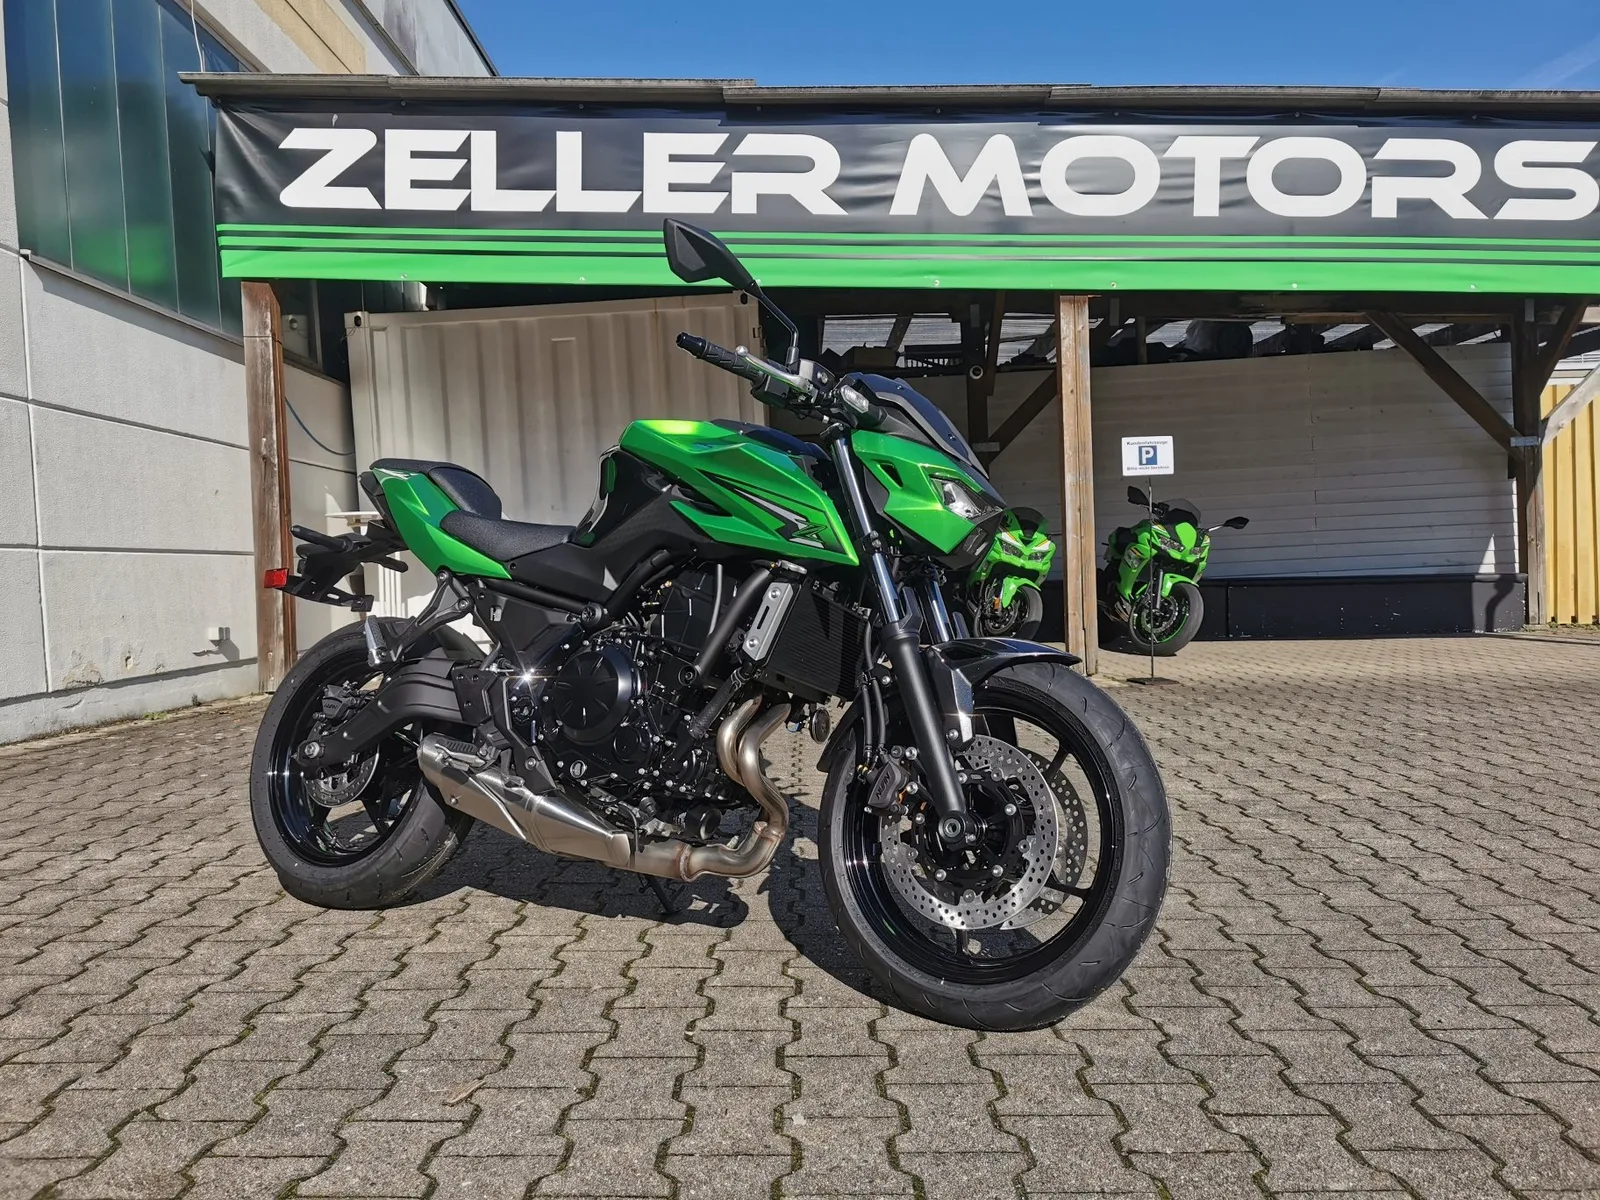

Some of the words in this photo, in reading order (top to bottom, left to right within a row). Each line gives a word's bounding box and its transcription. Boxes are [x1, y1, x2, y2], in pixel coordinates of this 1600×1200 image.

[278, 126, 849, 216] ZELLER
[889, 133, 1600, 221] MOTORS
[1141, 447, 1154, 464] P
